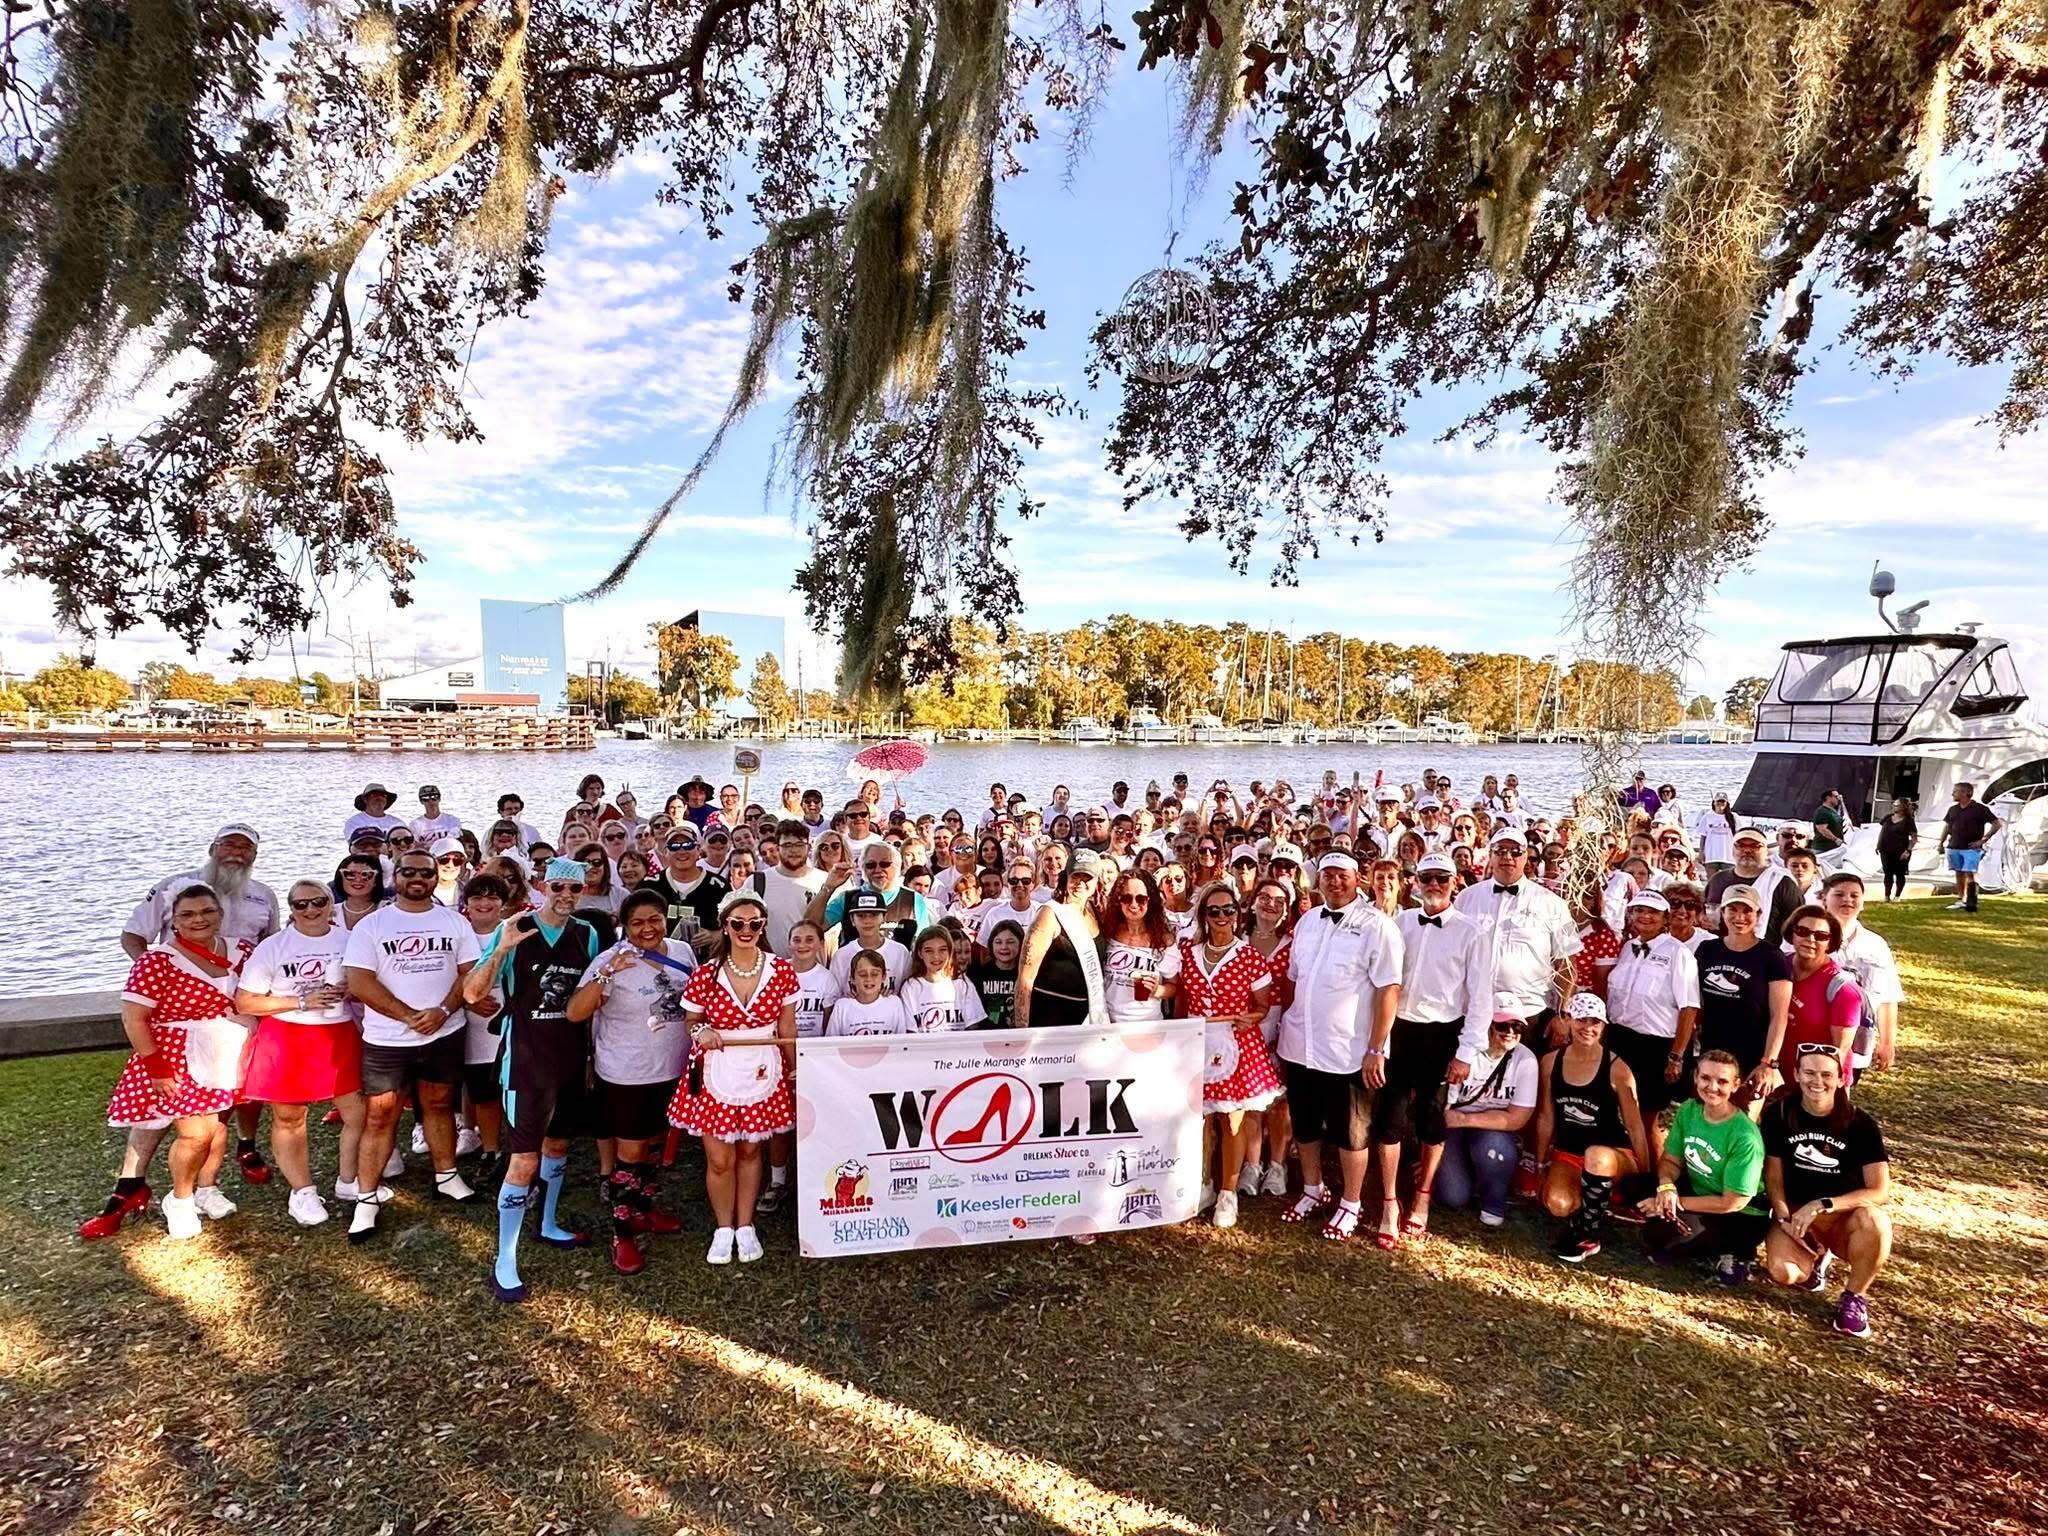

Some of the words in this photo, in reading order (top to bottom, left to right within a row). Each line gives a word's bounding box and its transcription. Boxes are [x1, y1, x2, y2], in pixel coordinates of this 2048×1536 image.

[934, 1060, 953, 1070] The
[955, 1058, 980, 1070] Julie
[983, 1056, 1027, 1068] Marange
[1029, 1053, 1076, 1065] Memorial
[1788, 1133, 1807, 1144] MADI
[1808, 1132, 1825, 1141] RUN
[1825, 1136, 1846, 1150] CLUB
[1023, 1151, 1053, 1161] ORLEANS
[1054, 1147, 1079, 1159] Shoe
[1137, 1156, 1180, 1172] Harbor
[1121, 1193, 1161, 1214] ABITA
[831, 1216, 907, 1232] LOUISIANA
[833, 1225, 910, 1245] SEAFOOD
